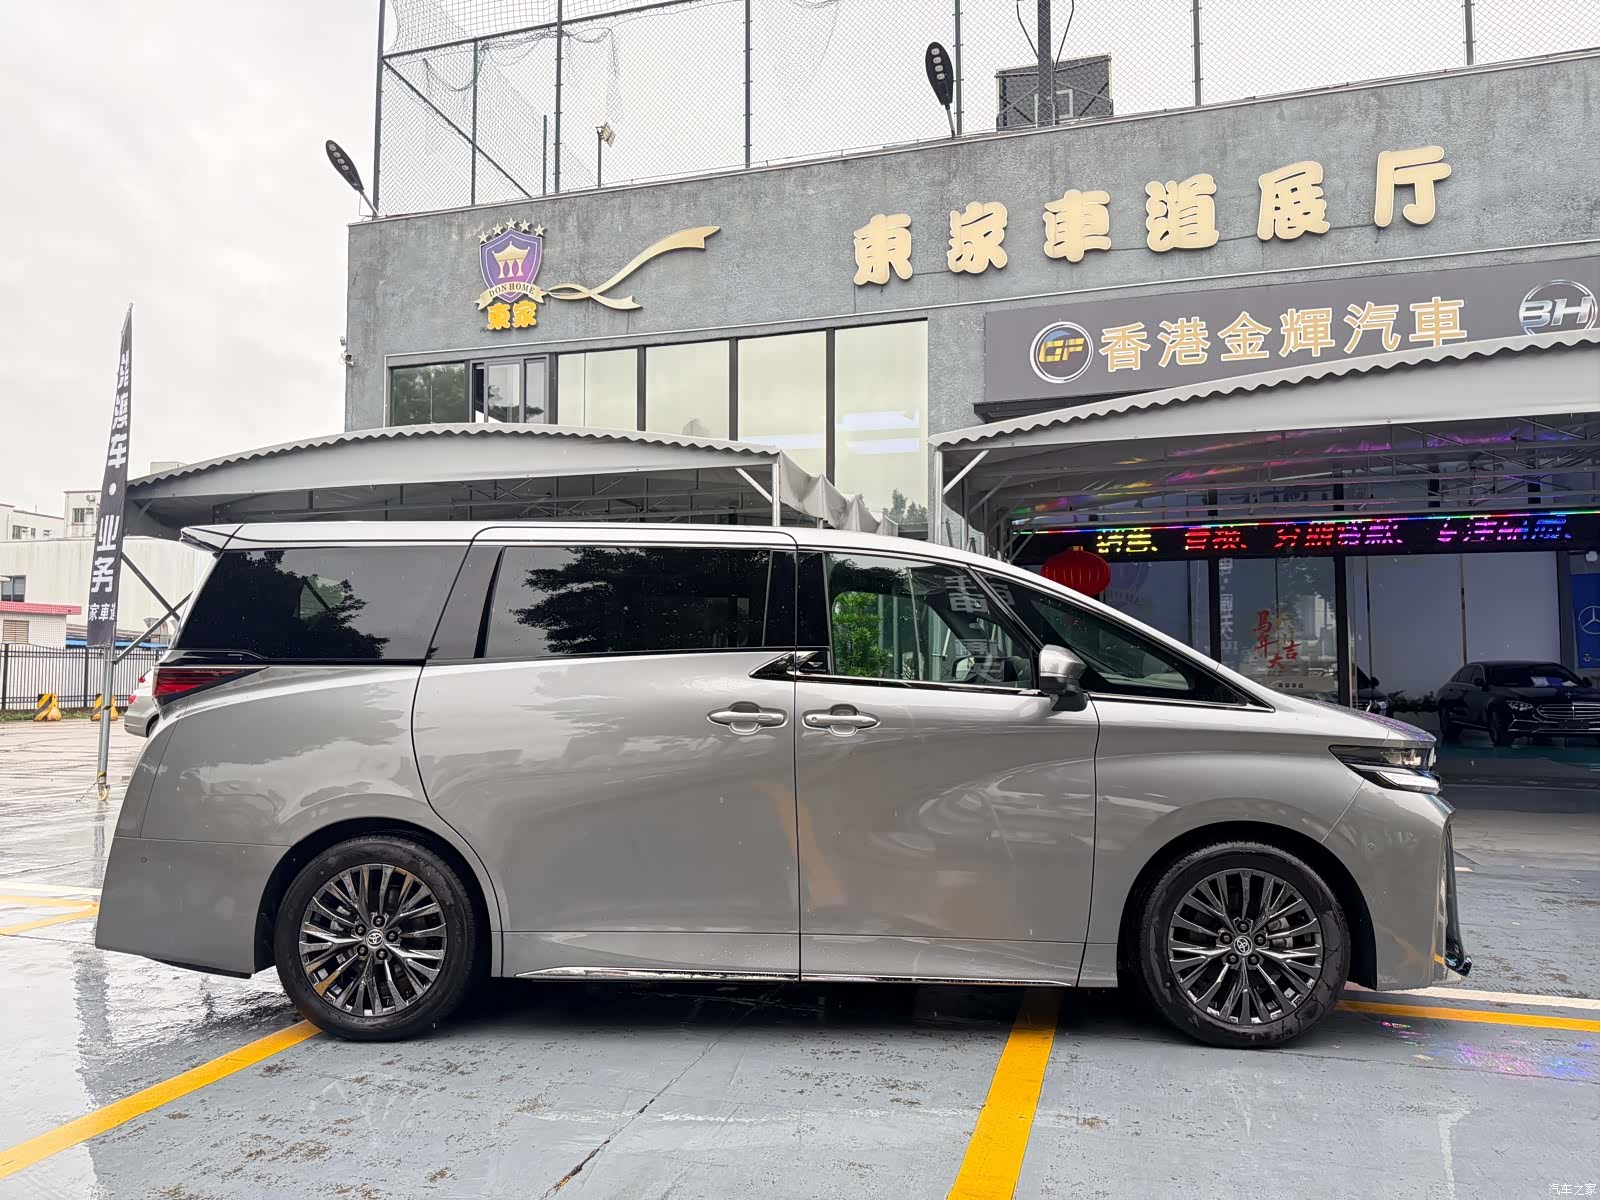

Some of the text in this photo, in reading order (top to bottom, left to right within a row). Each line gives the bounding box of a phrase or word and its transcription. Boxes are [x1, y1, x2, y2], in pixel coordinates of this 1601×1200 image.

[489, 283, 536, 298] DON HOME
[487, 300, 537, 330] 東家
[1099, 296, 1468, 372] 香港金輝汽車
